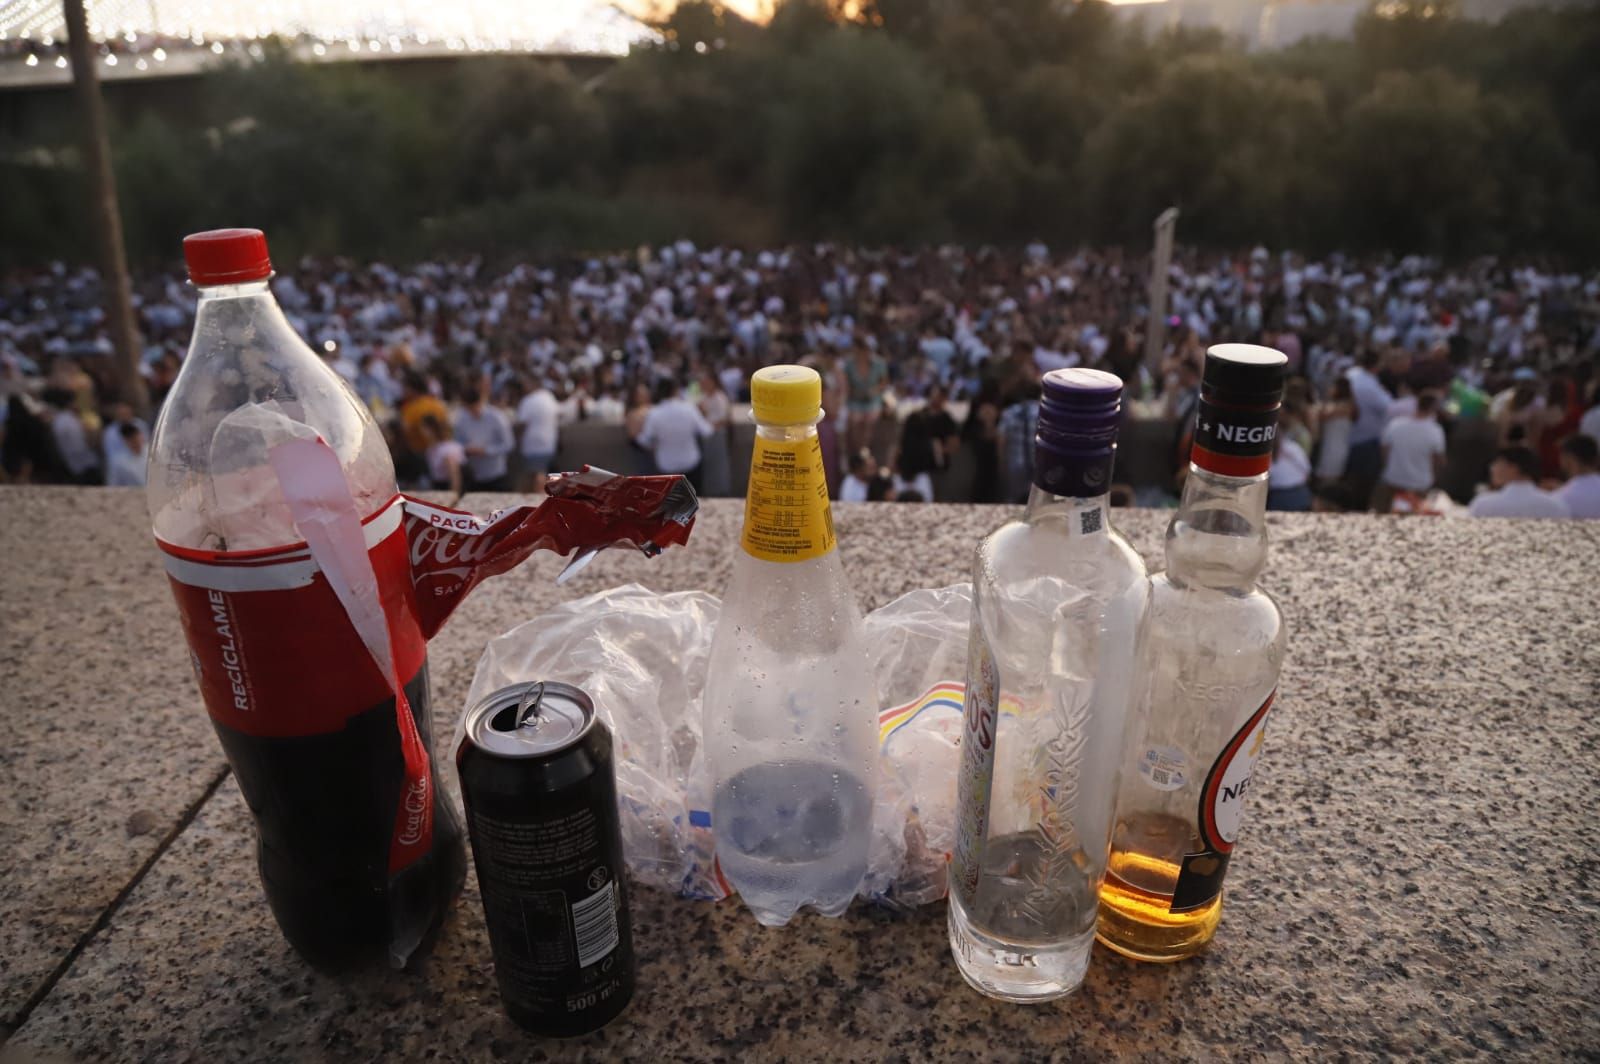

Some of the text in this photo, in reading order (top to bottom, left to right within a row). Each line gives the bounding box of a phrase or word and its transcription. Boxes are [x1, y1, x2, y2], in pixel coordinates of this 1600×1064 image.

[430, 513, 481, 531] PACK
[406, 517, 490, 567] oca
[208, 590, 248, 711] RECÍCLAME
[1222, 775, 1252, 802] NE
[567, 992, 597, 1012] 500
